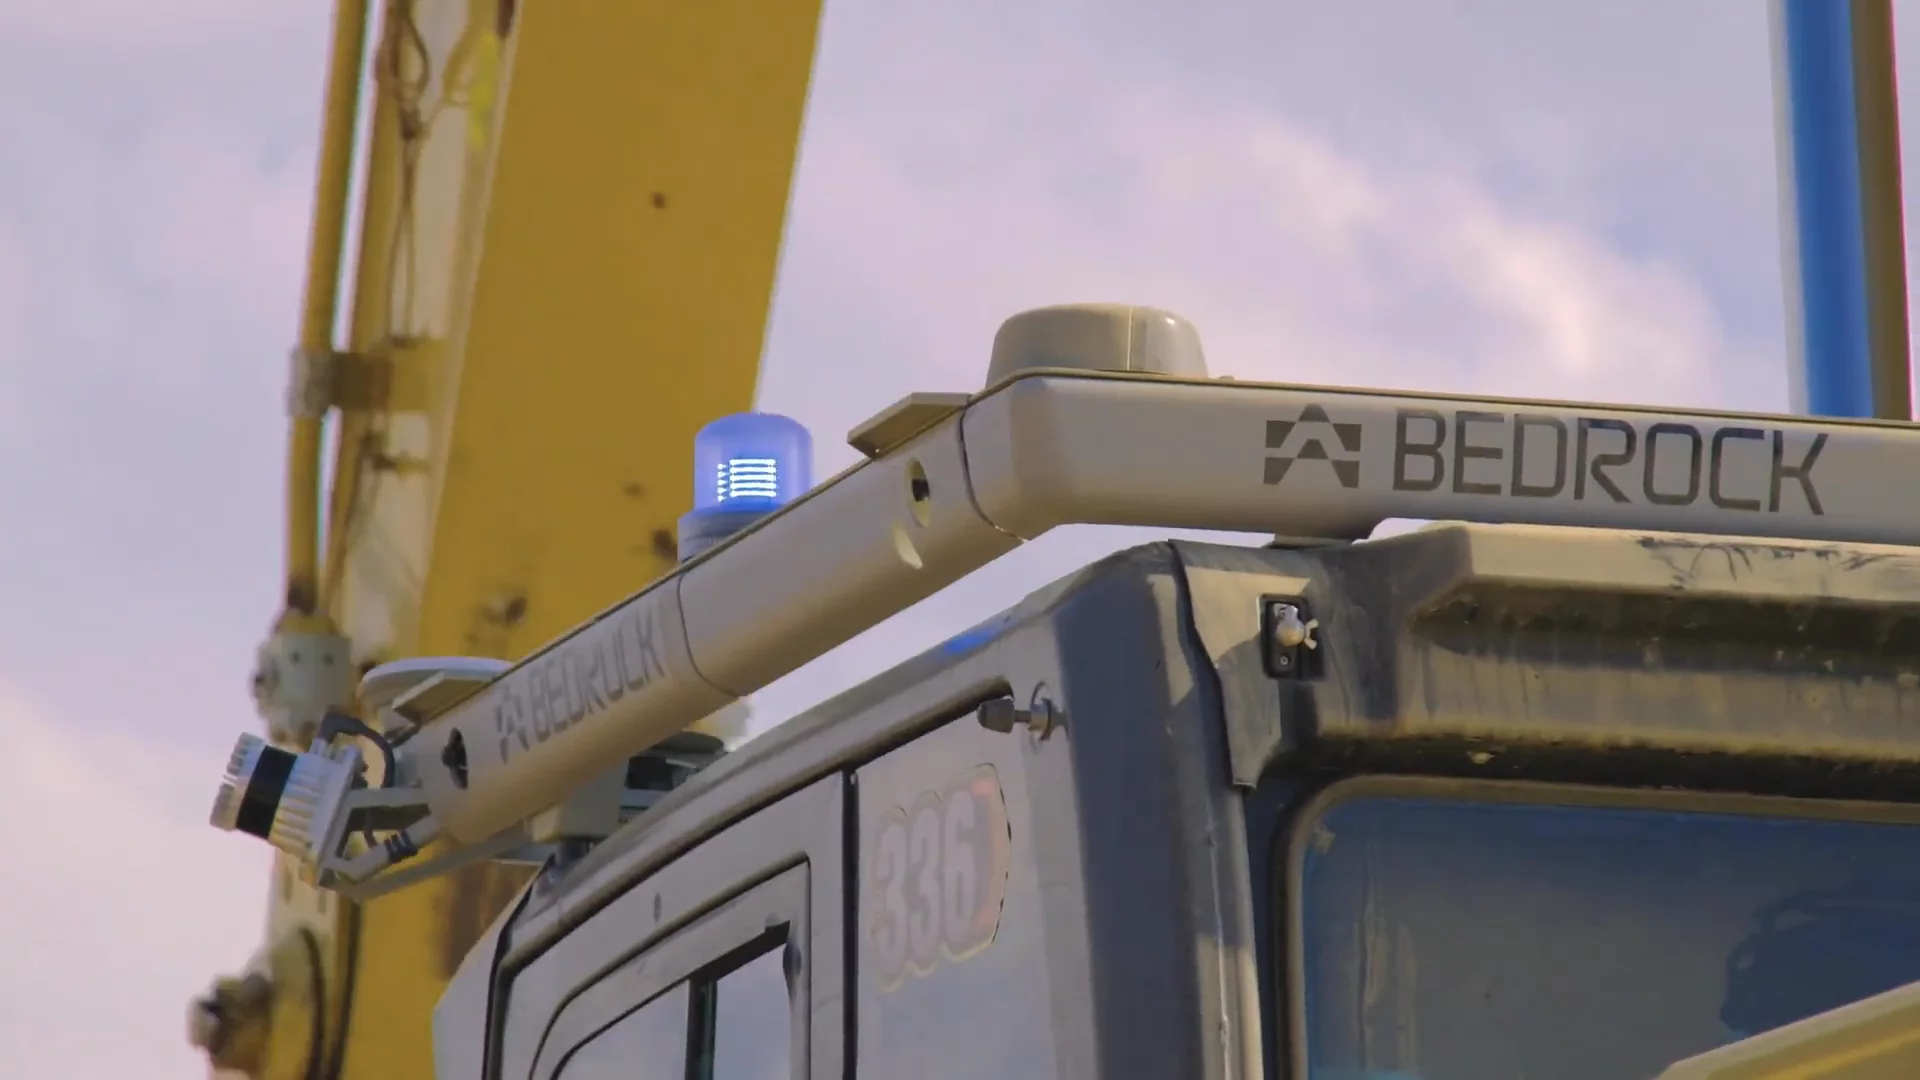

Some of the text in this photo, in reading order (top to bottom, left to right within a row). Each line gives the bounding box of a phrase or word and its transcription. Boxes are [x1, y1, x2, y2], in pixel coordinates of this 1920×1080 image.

[1393, 408, 1828, 516] BEDROCK
[528, 602, 666, 743] BEDROCK
[873, 786, 977, 978] 336
